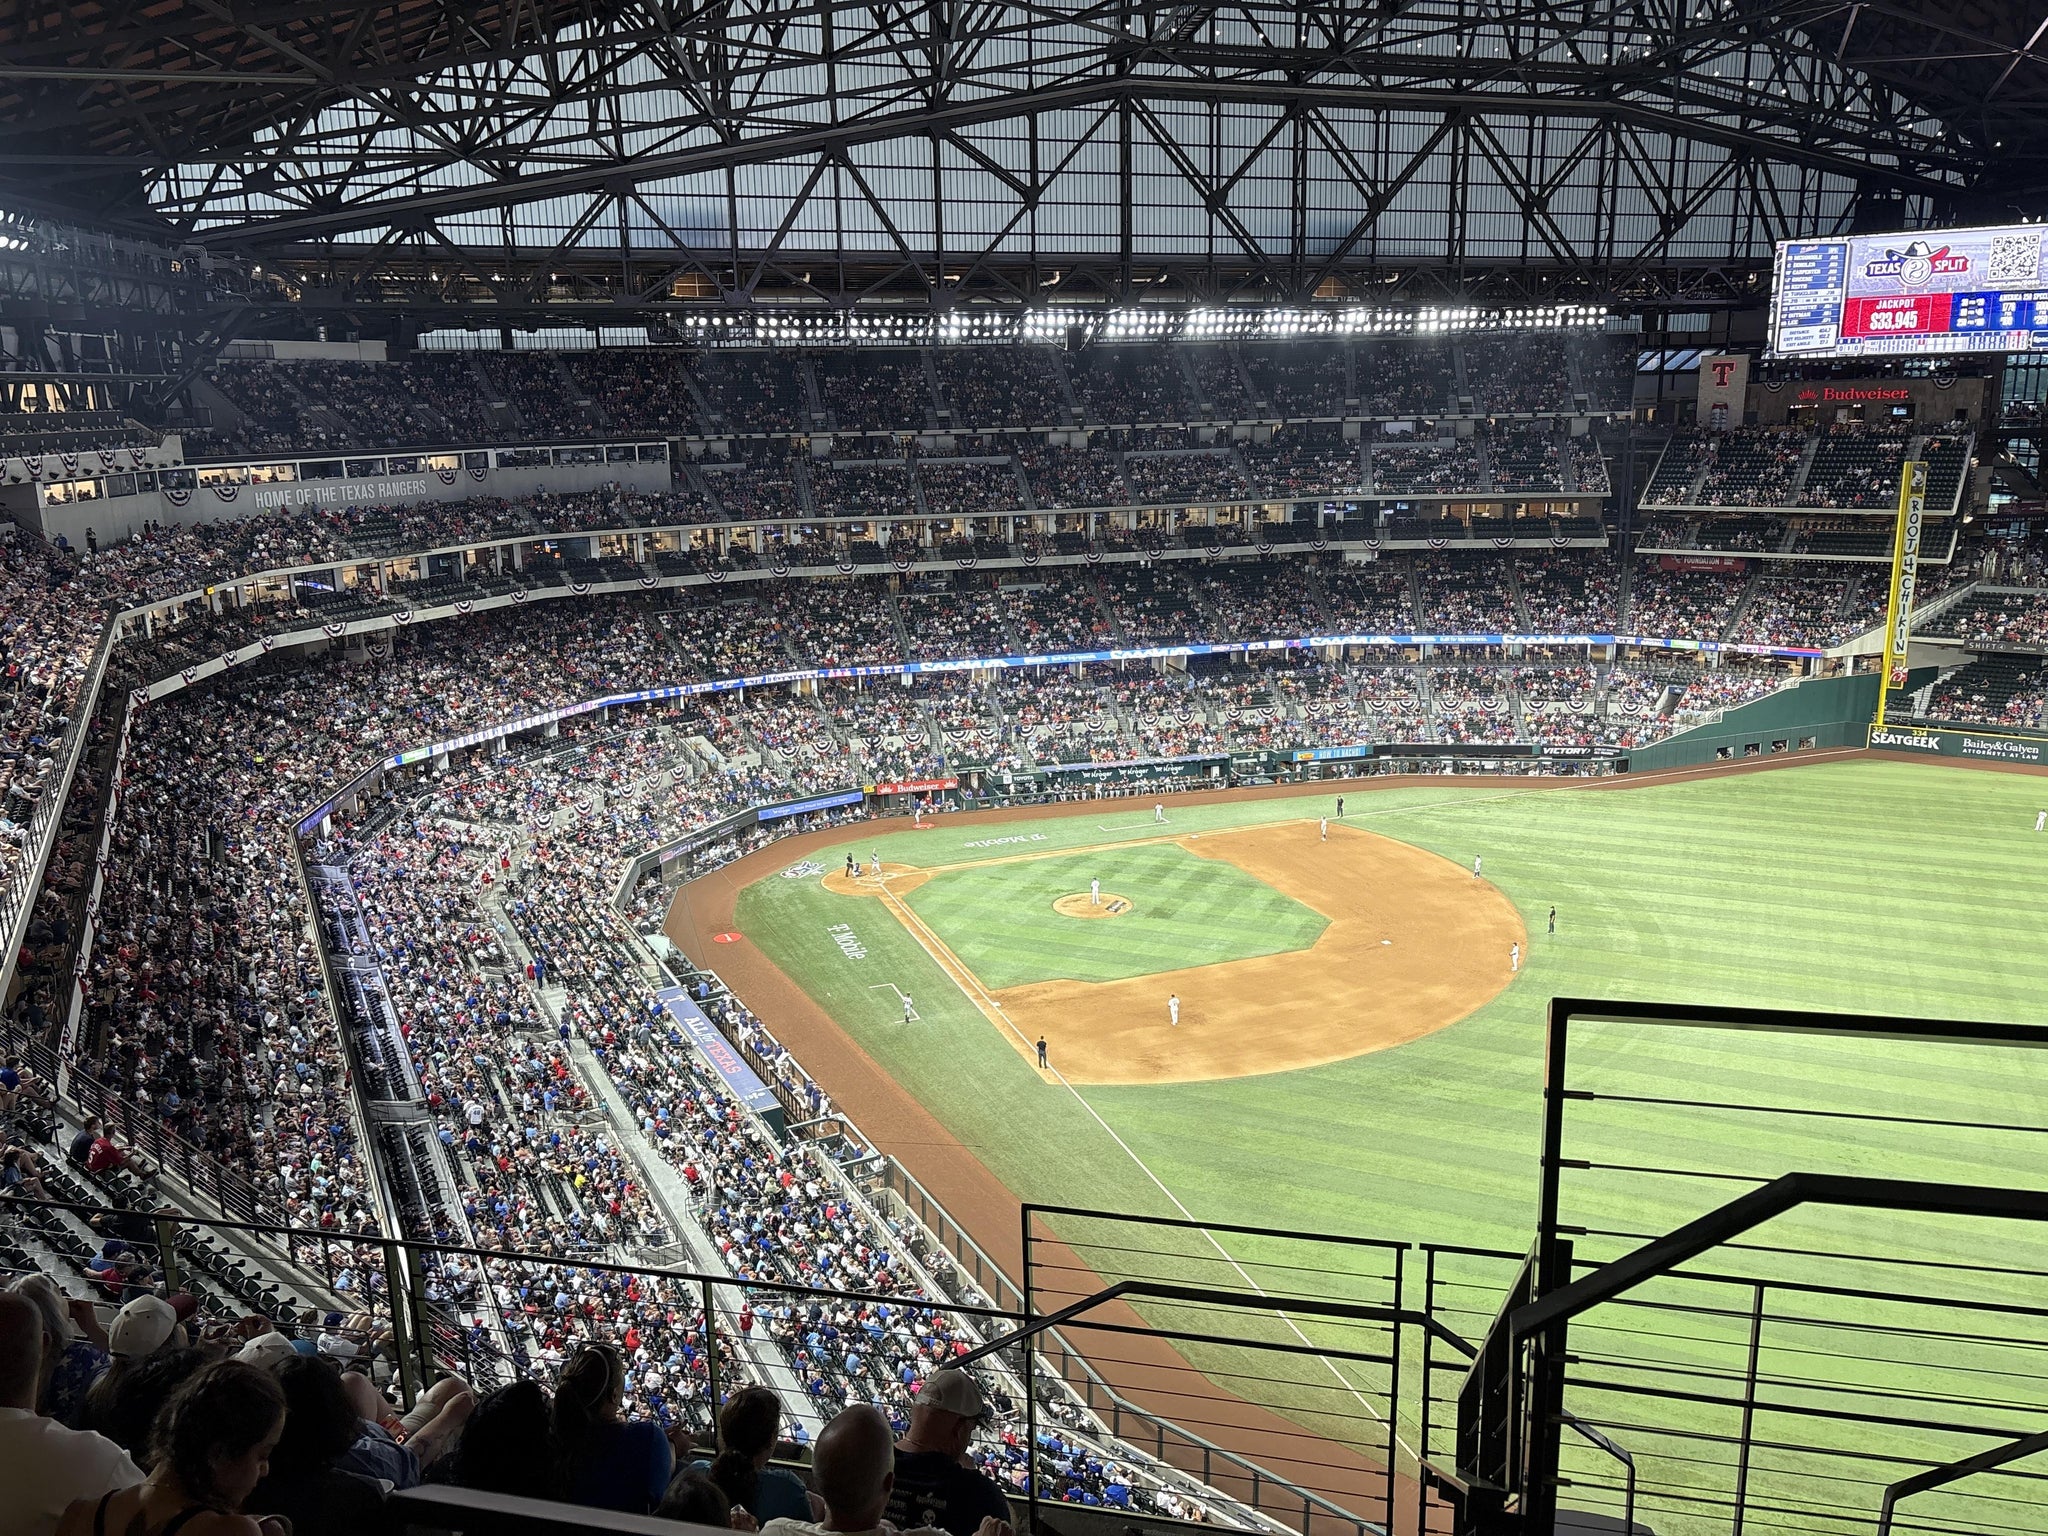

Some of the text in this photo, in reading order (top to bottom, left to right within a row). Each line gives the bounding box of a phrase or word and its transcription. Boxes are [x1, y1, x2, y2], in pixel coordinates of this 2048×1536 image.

[1868, 262, 1900, 275] TEXAS
[1934, 260, 1965, 272] SPLIT
[1876, 298, 1916, 310] JACKPOT
[1870, 310, 1918, 331] $33,945
[1712, 362, 1736, 388] T
[1824, 386, 1908, 400] Budweiser
[254, 480, 427, 508] HOME OF THE TEXAS RANGERS
[1684, 556, 1720, 565] FOUNDATION
[1968, 642, 1997, 650] SHIFT
[1912, 729, 1928, 737] 334
[1871, 732, 1940, 750] SEATGEEK
[1962, 748, 2006, 757] ATTORNEYS
[1128, 768, 1149, 778] Kroger
[1164, 764, 1184, 775] Kroger
[1092, 771, 1112, 781] Kroger
[896, 782, 939, 793] Budweiser
[684, 1016, 708, 1036] ALL
[706, 1041, 743, 1074] TEXAS
